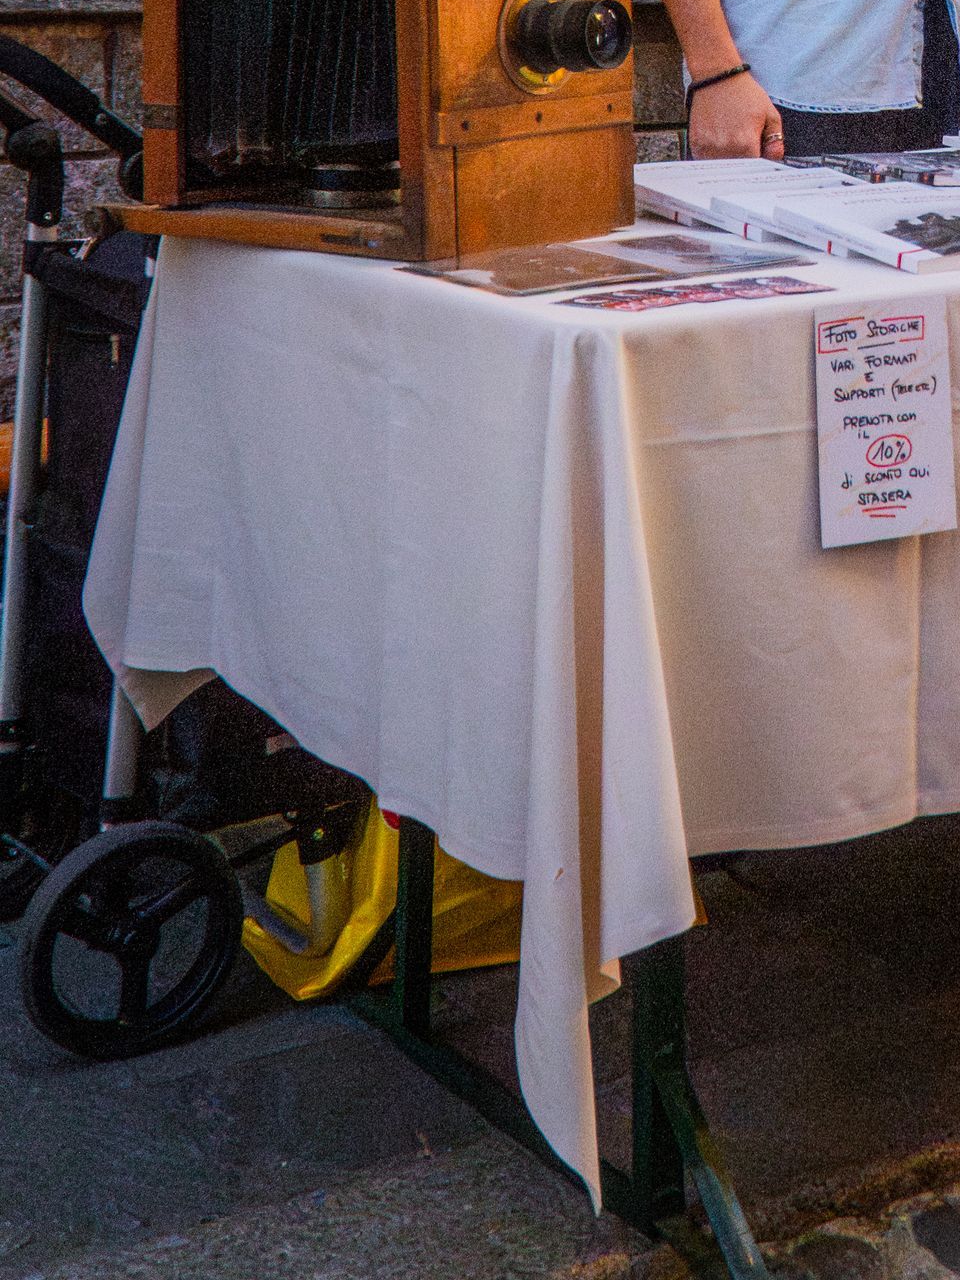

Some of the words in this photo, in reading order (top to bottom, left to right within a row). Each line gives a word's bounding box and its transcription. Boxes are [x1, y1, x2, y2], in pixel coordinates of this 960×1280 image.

[822, 322, 858, 344] FOTO
[867, 320, 920, 338] STORICHE
[864, 372, 874, 383] E
[843, 413, 893, 430] PRENOTA
[872, 439, 906, 463] 10%
[864, 469, 902, 484] SCONTO
[858, 491, 912, 506] STASERA
